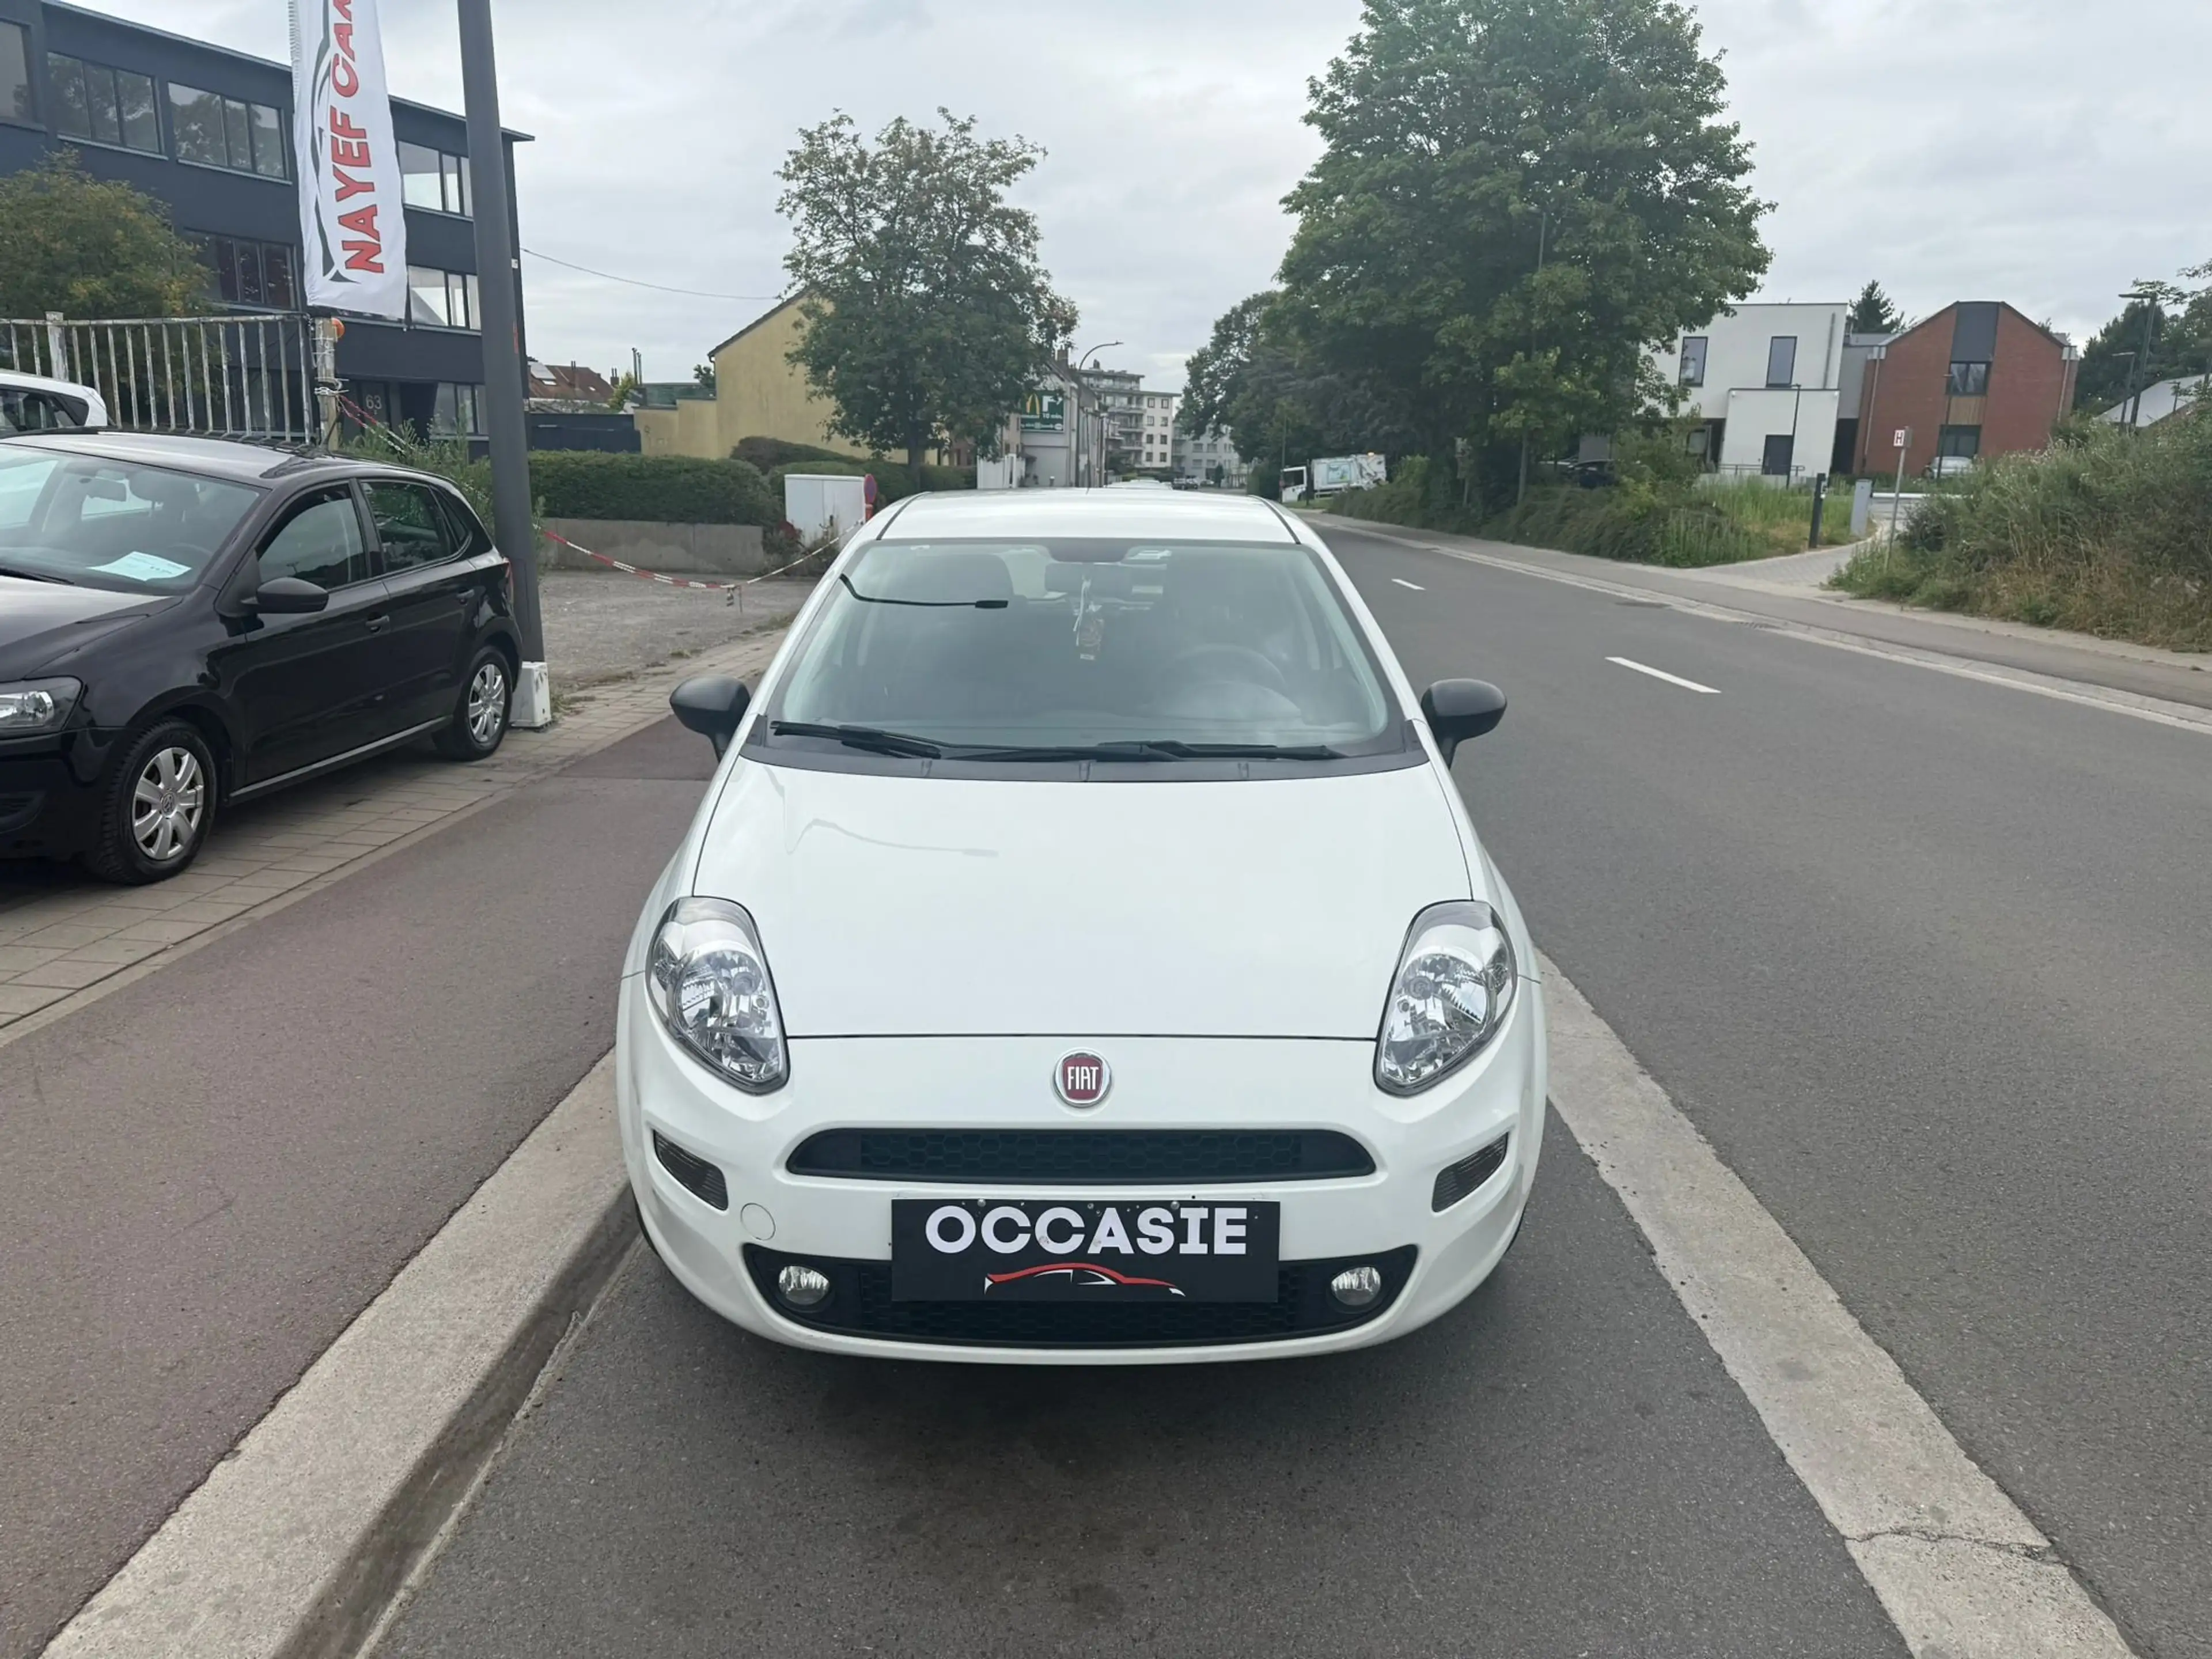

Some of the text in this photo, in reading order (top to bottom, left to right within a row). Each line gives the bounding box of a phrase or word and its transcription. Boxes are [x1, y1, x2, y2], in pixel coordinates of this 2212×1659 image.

[330, 105, 384, 274] NAYEF
[366, 394, 382, 409] 63
[1896, 432, 1903, 444] H
[1067, 1066, 1099, 1090] FIAT
[925, 1205, 1247, 1255] OCCASIE
